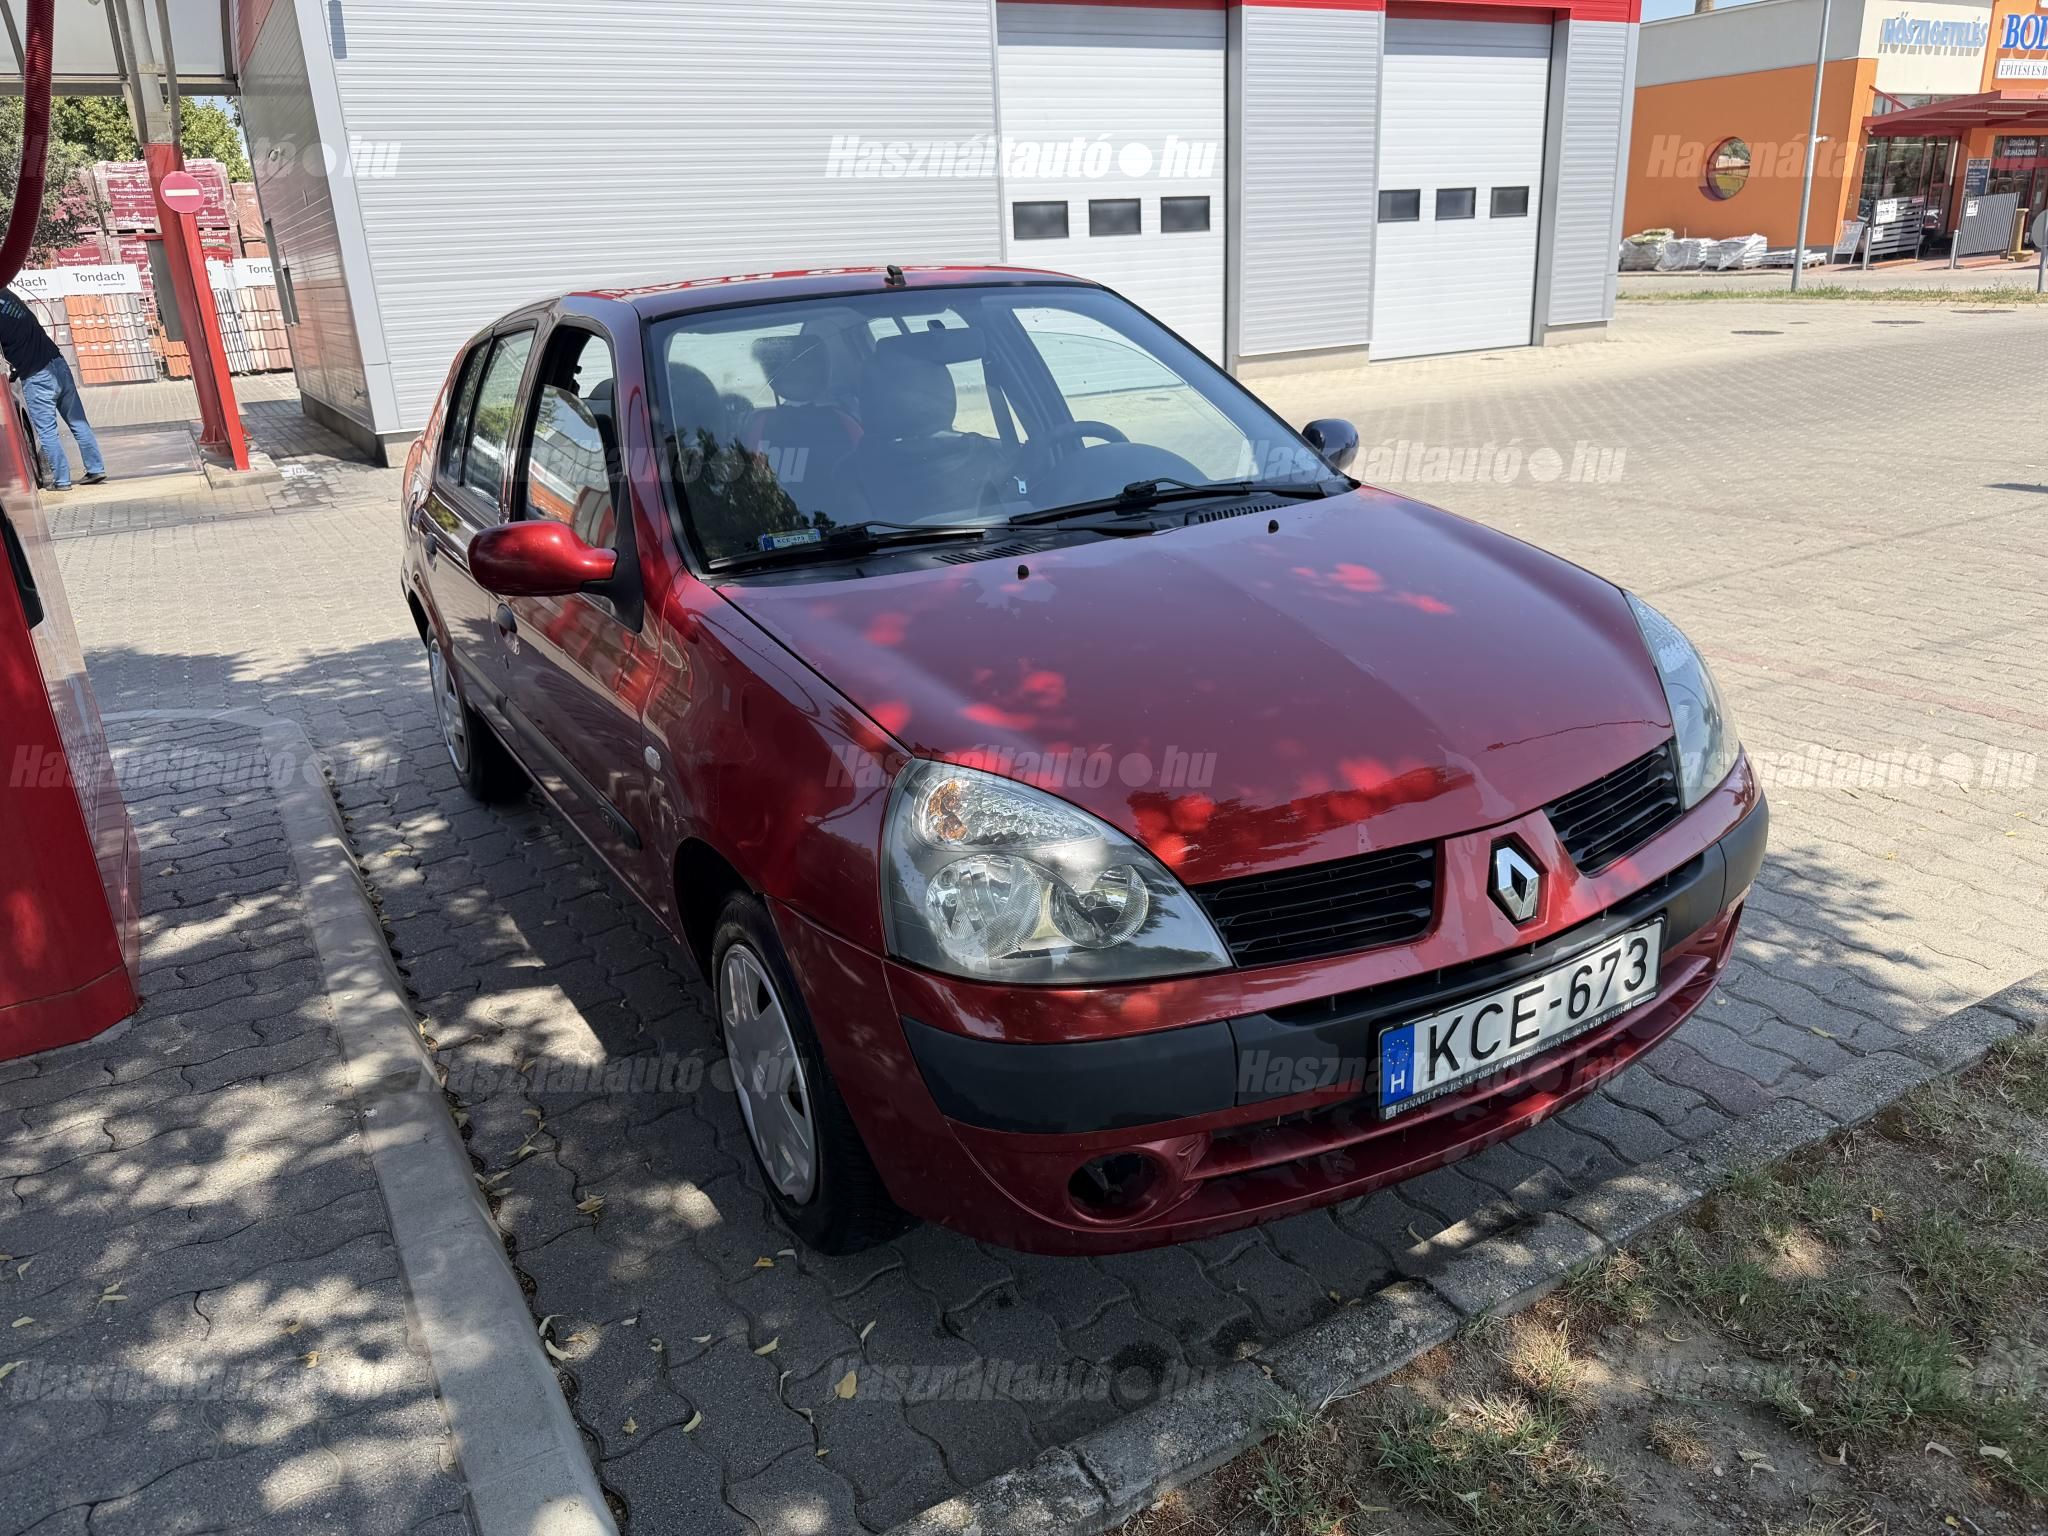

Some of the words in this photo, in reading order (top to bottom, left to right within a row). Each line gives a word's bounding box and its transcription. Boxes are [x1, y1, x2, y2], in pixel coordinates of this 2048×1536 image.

[9, 276, 47, 288] ndach
[73, 271, 125, 283] Tondach
[1427, 937, 1648, 1082] KCE-673
[1390, 1070, 1405, 1094] H
[1396, 1089, 1438, 1113] RENAULT
